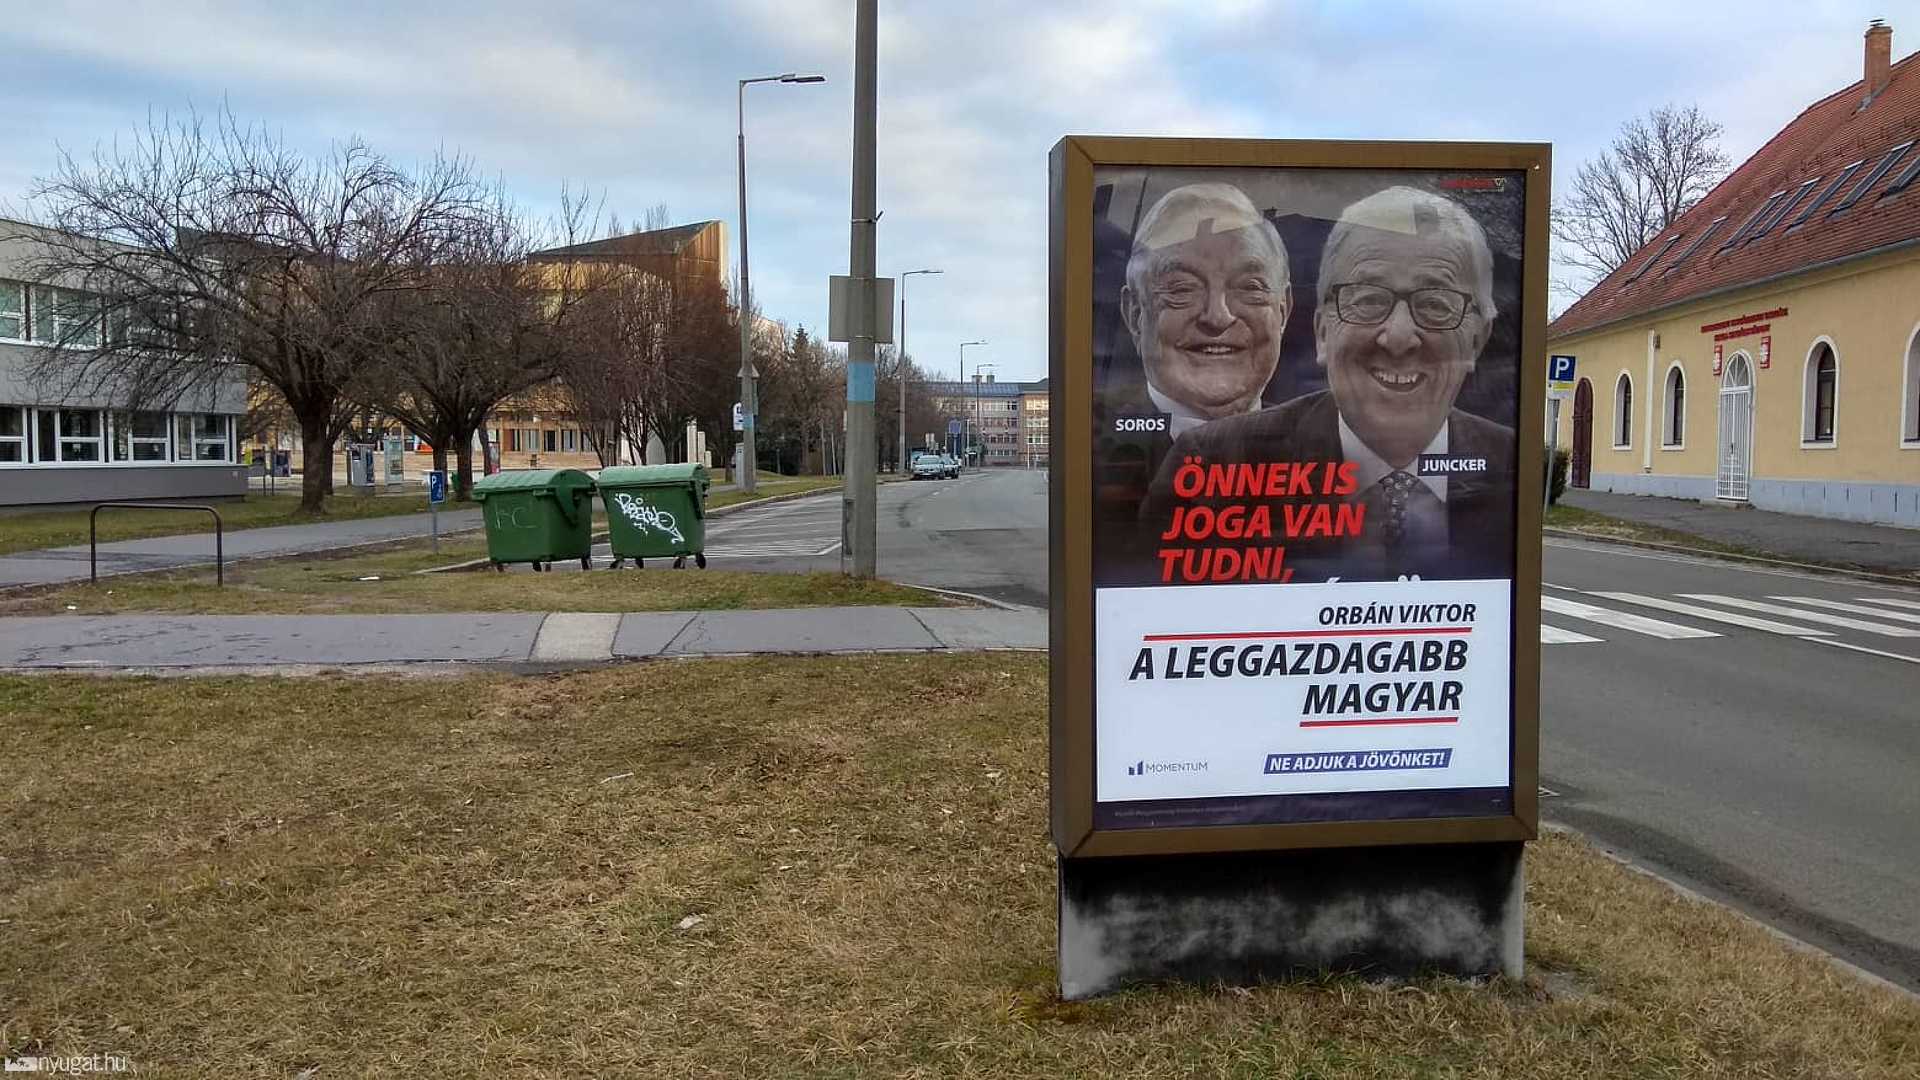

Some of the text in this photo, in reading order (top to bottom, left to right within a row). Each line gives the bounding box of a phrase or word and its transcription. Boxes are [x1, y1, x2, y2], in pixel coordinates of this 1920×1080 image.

[1555, 357, 1570, 378] P
[1115, 418, 1166, 432] SOROS
[1173, 456, 1360, 498] ÖNNEK IS
[1422, 458, 1487, 472] JUNCKER
[1161, 502, 1366, 541] JOGA VAN
[1157, 546, 1296, 583] TUDNI,
[1319, 601, 1477, 625] ORBÁN VIKTOR
[1129, 639, 1468, 680] A LEGGAZDAGABB
[1302, 681, 1463, 715] MAGYAR
[1146, 762, 1208, 773] MOMENTUM
[1270, 757, 1291, 771] NE
[1293, 755, 1345, 771] ADJUK
[1346, 756, 1358, 769] A
